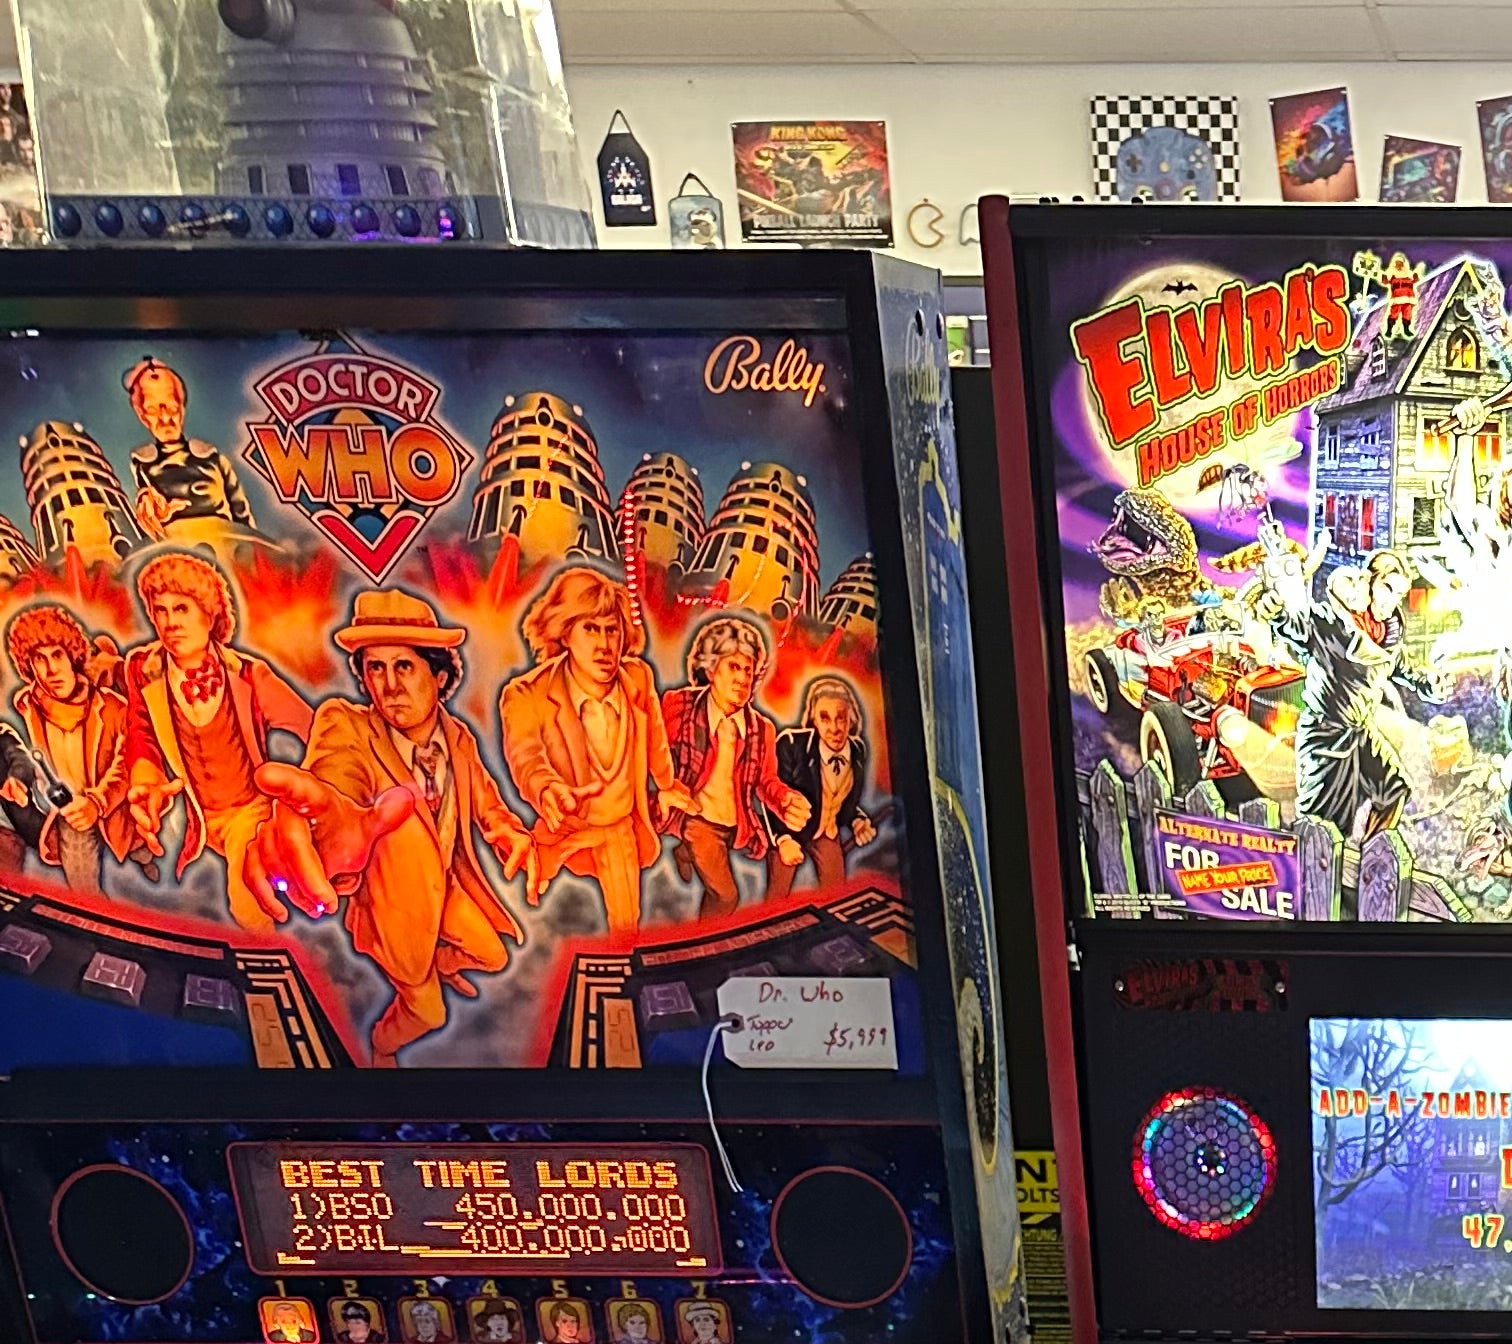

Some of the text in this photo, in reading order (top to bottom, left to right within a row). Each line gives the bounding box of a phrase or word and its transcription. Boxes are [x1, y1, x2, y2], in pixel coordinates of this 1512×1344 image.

[770, 126, 847, 141] KING KONG
[1074, 267, 1348, 445] ELVIRA'S
[270, 359, 426, 418] DOCTOR
[1137, 359, 1339, 487] HOUSE OF HORRORS
[250, 423, 462, 507] WHO
[1158, 815, 1297, 856] ALTERNATE REALTY
[1164, 841, 1220, 872] FOR
[1181, 864, 1272, 889] NAME YOUR PRICE
[1221, 887, 1295, 921] SALE
[1319, 1089, 1511, 1120] ADD-A-ZOMBIE
[280, 1160, 679, 1189] BEST TIME LORDS
[273, 1280, 287, 1297] 1
[343, 1281, 360, 1297] 2
[414, 1281, 430, 1297] 3
[481, 1281, 498, 1297] 4
[551, 1281, 567, 1297] 5
[621, 1281, 637, 1297] 6
[690, 1281, 706, 1297] 7
